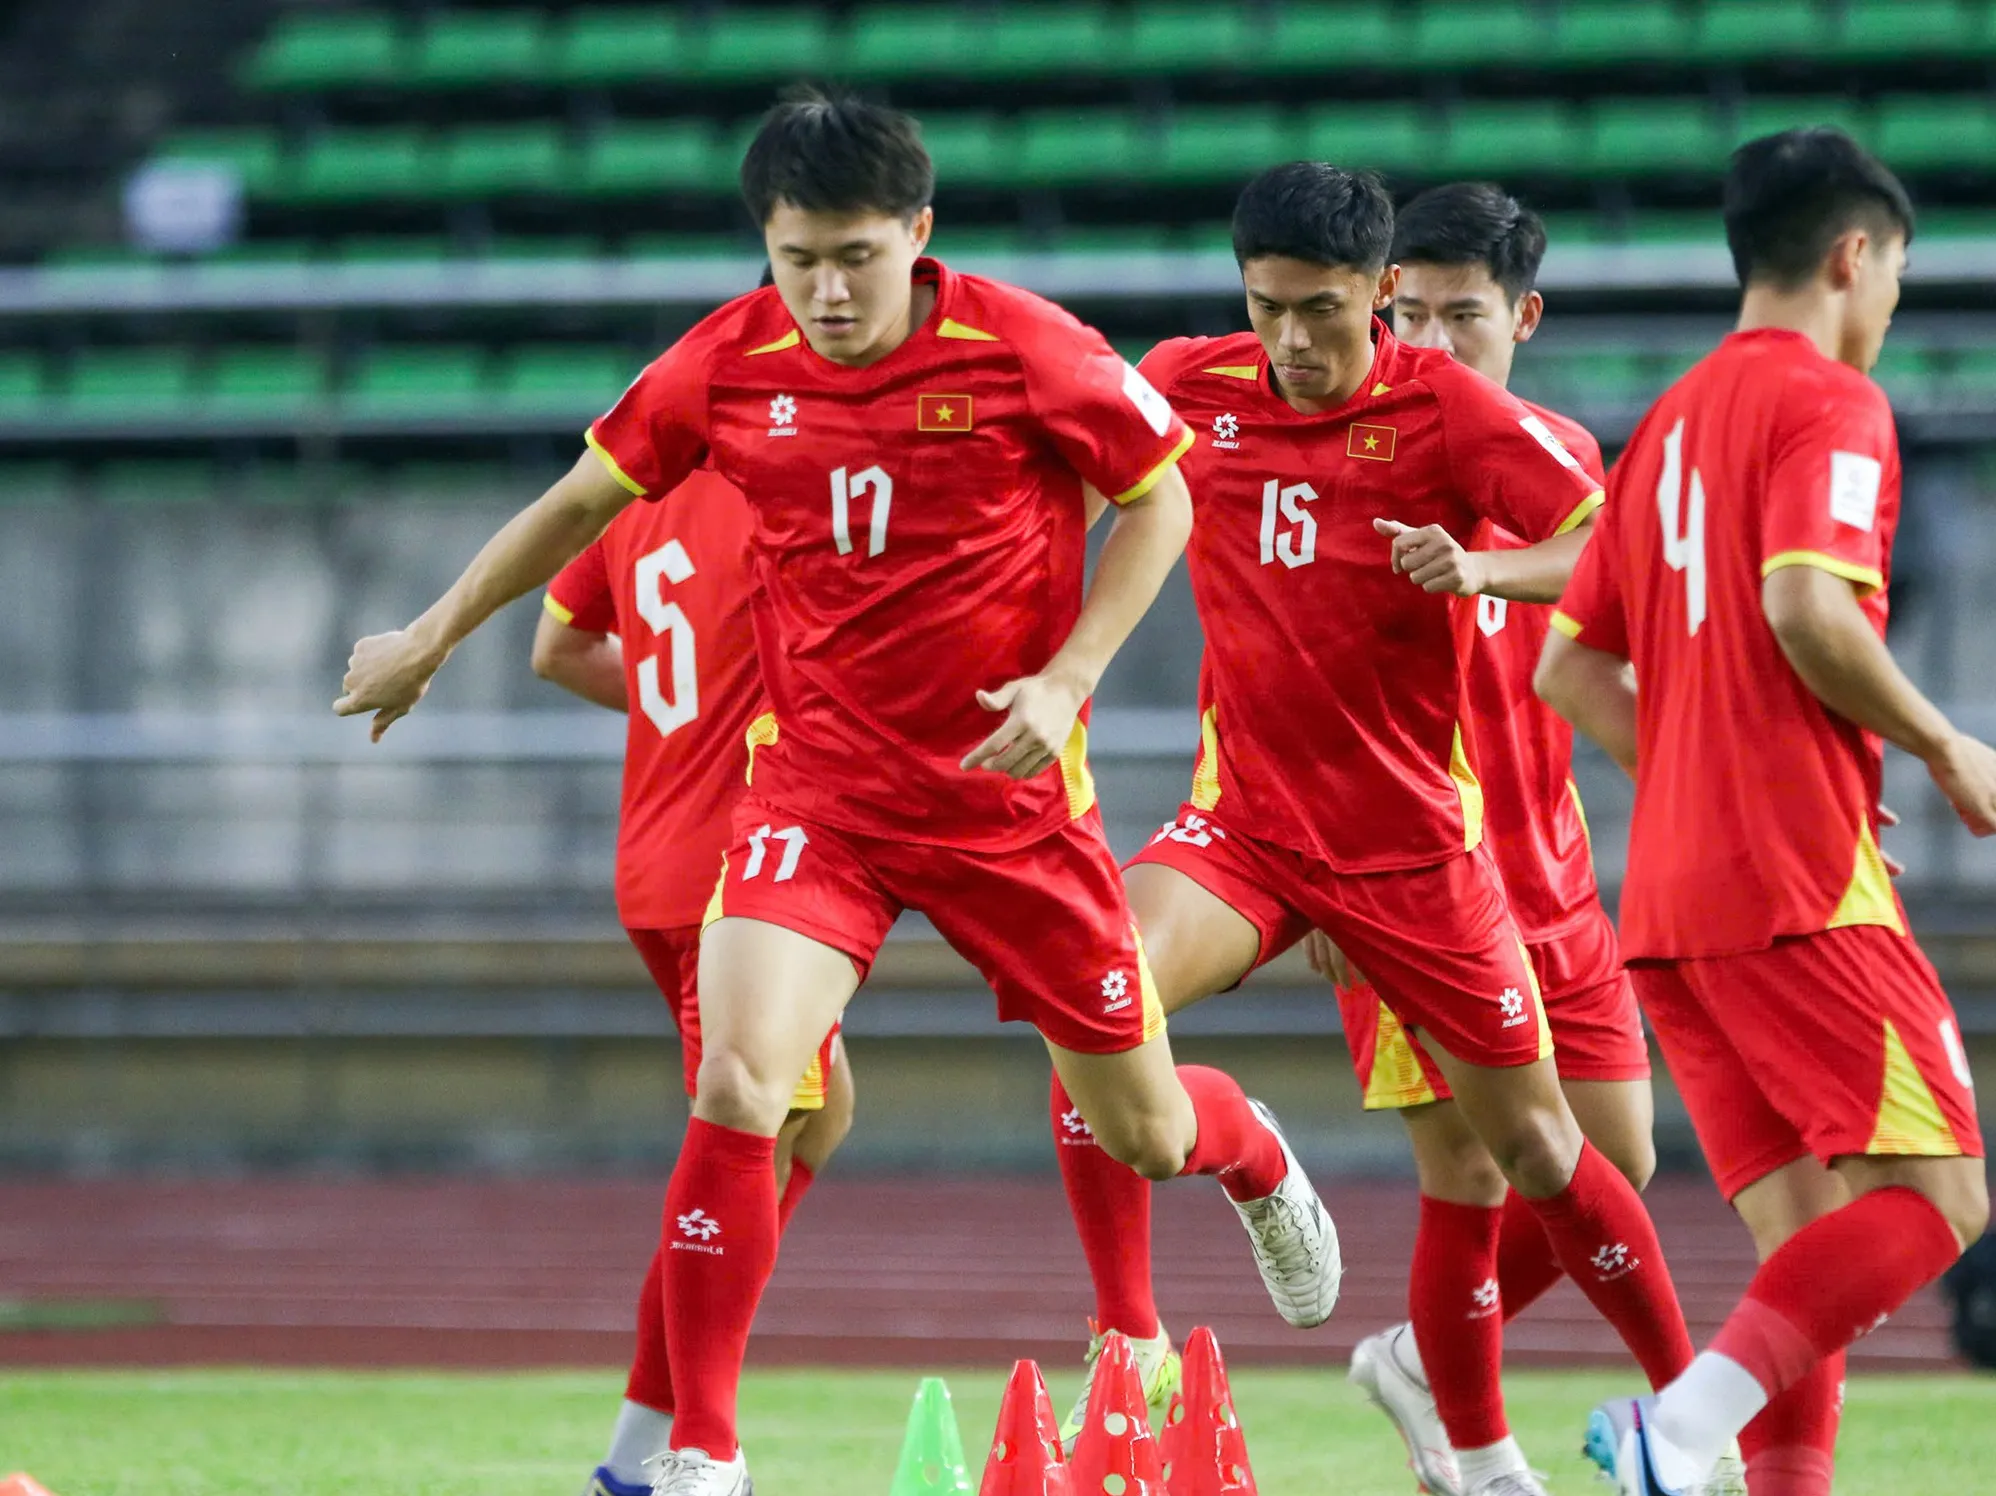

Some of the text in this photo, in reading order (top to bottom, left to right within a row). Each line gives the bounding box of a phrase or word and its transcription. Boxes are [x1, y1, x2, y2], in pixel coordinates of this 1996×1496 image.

[830, 464, 893, 558] 17
[1259, 478, 1319, 570] 15
[1656, 416, 1706, 638] 4
[635, 538, 698, 738] 5
[742, 823, 810, 882] 17
